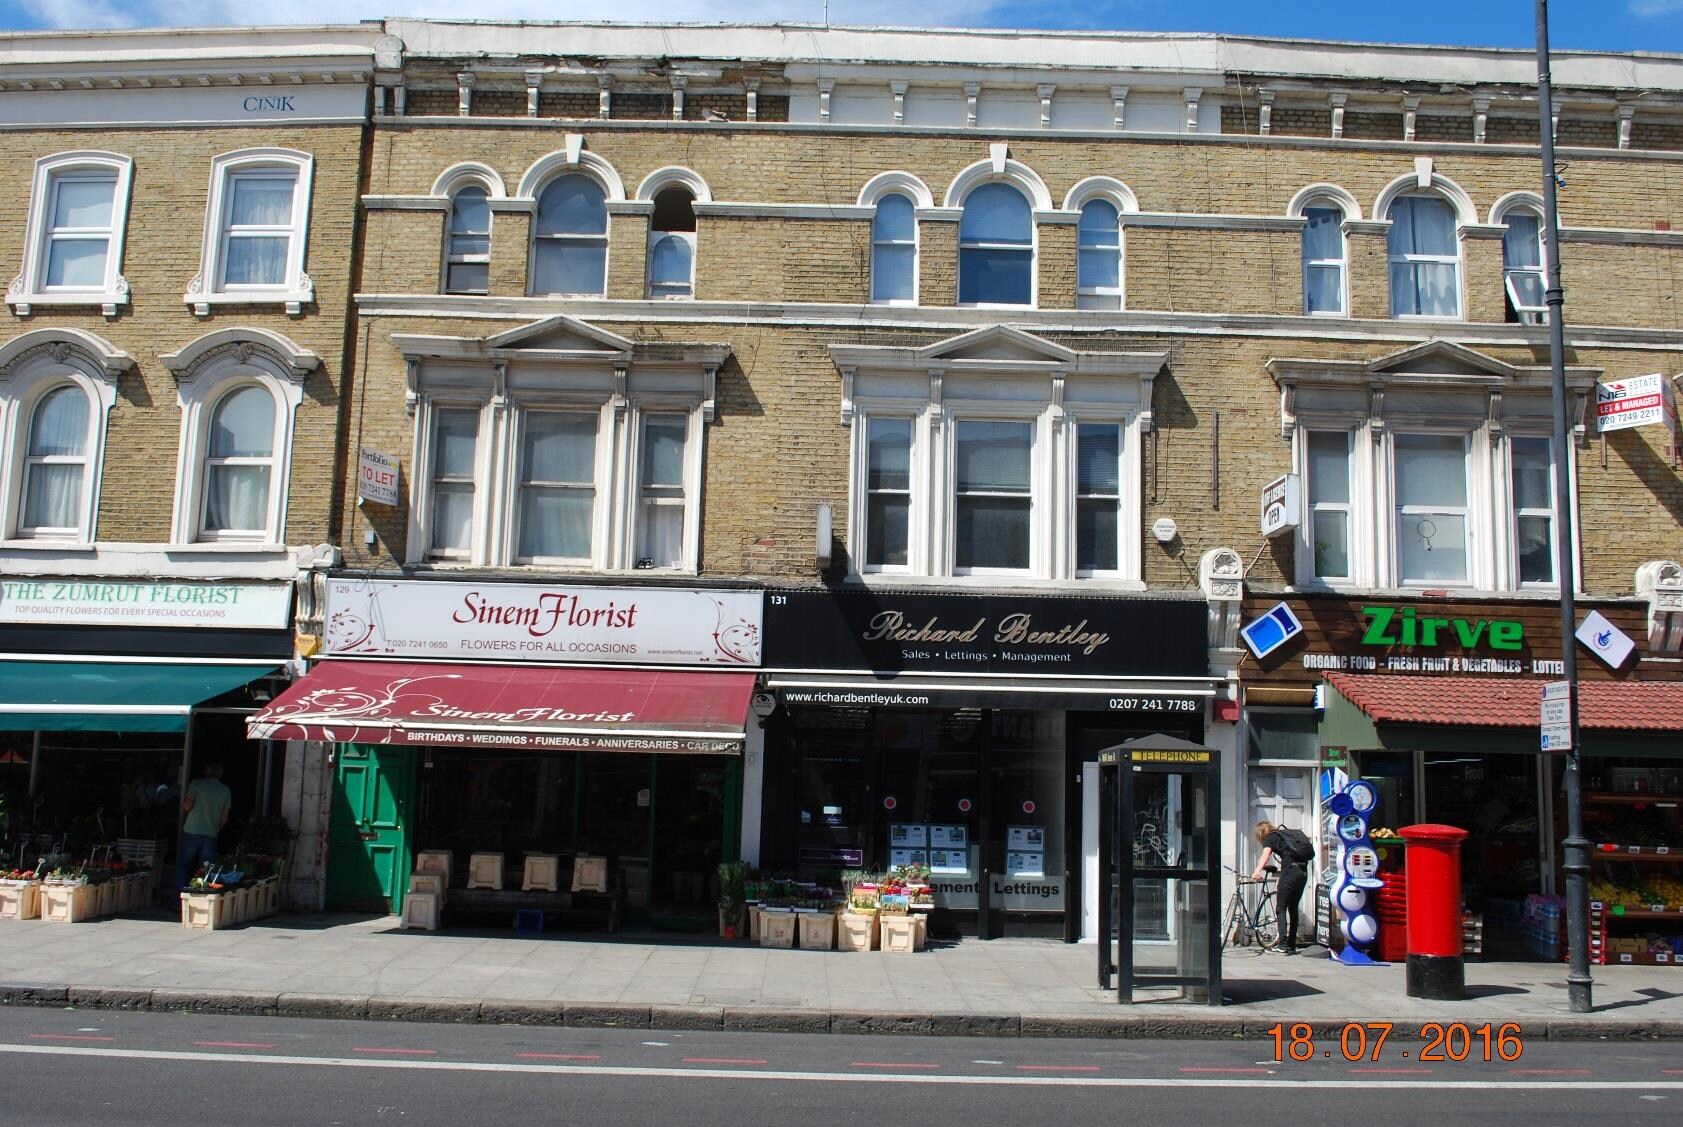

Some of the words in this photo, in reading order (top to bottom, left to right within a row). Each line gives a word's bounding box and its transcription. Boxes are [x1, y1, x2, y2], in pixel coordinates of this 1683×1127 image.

[243, 95, 295, 112] CINIK
[1629, 377, 1659, 391] ESTATE
[1600, 404, 1614, 414] LET
[1614, 402, 1621, 411] &
[1622, 395, 1659, 410] MANAGED
[1600, 415, 1615, 426] 020
[1618, 411, 1637, 422] 7249
[1640, 408, 1660, 419] 2211
[363, 466, 373, 480] TO
[375, 471, 395, 486] LET
[4, 583, 46, 600] THE
[52, 584, 145, 603] ZUMRUT
[150, 585, 244, 605] FLORIST
[335, 586, 350, 594] 129
[770, 595, 787, 605] 131
[15, 605, 31, 614] TOP
[31, 606, 64, 615] QUALITY
[66, 606, 102, 616] FLOWERS
[104, 607, 120, 616] FOR
[121, 607, 146, 617] EVERY
[147, 608, 178, 617] SPECIAL
[180, 608, 226, 618] OCCASIONS
[862, 610, 987, 643] Richard
[993, 612, 1110, 656] Bentley
[1360, 605, 1524, 650] Zirve
[408, 639, 427, 649] 7241
[429, 640, 448, 650] 0650
[460, 639, 517, 651] FLOWERS
[520, 640, 543, 651] FOR
[545, 641, 566, 652] ALL
[568, 641, 638, 654] OCCASIONS
[901, 649, 931, 659] Sales
[944, 650, 989, 662] Lettings
[1001, 651, 1072, 663] Management
[1303, 654, 1348, 669] ORGANIC
[1349, 655, 1376, 670] FOOD
[1387, 656, 1420, 671] FRESH
[1422, 657, 1450, 672] FRUIT
[1451, 657, 1460, 672] &
[1461, 657, 1522, 673] VEGETABLES
[785, 691, 930, 706] www.richardbentleyuk.com
[1109, 698, 1138, 710] 0207
[1141, 699, 1163, 710] 241
[1167, 700, 1196, 711] 7788
[407, 731, 465, 743] BIRTHDAYS
[472, 734, 527, 744] WEDDINGS
[534, 736, 590, 747] FUNERALS
[596, 738, 679, 750] ANNIVERSARIES
[686, 741, 709, 751] CAR
[1140, 751, 1202, 761] TELEPHONE
[994, 881, 1060, 898] Lettings
